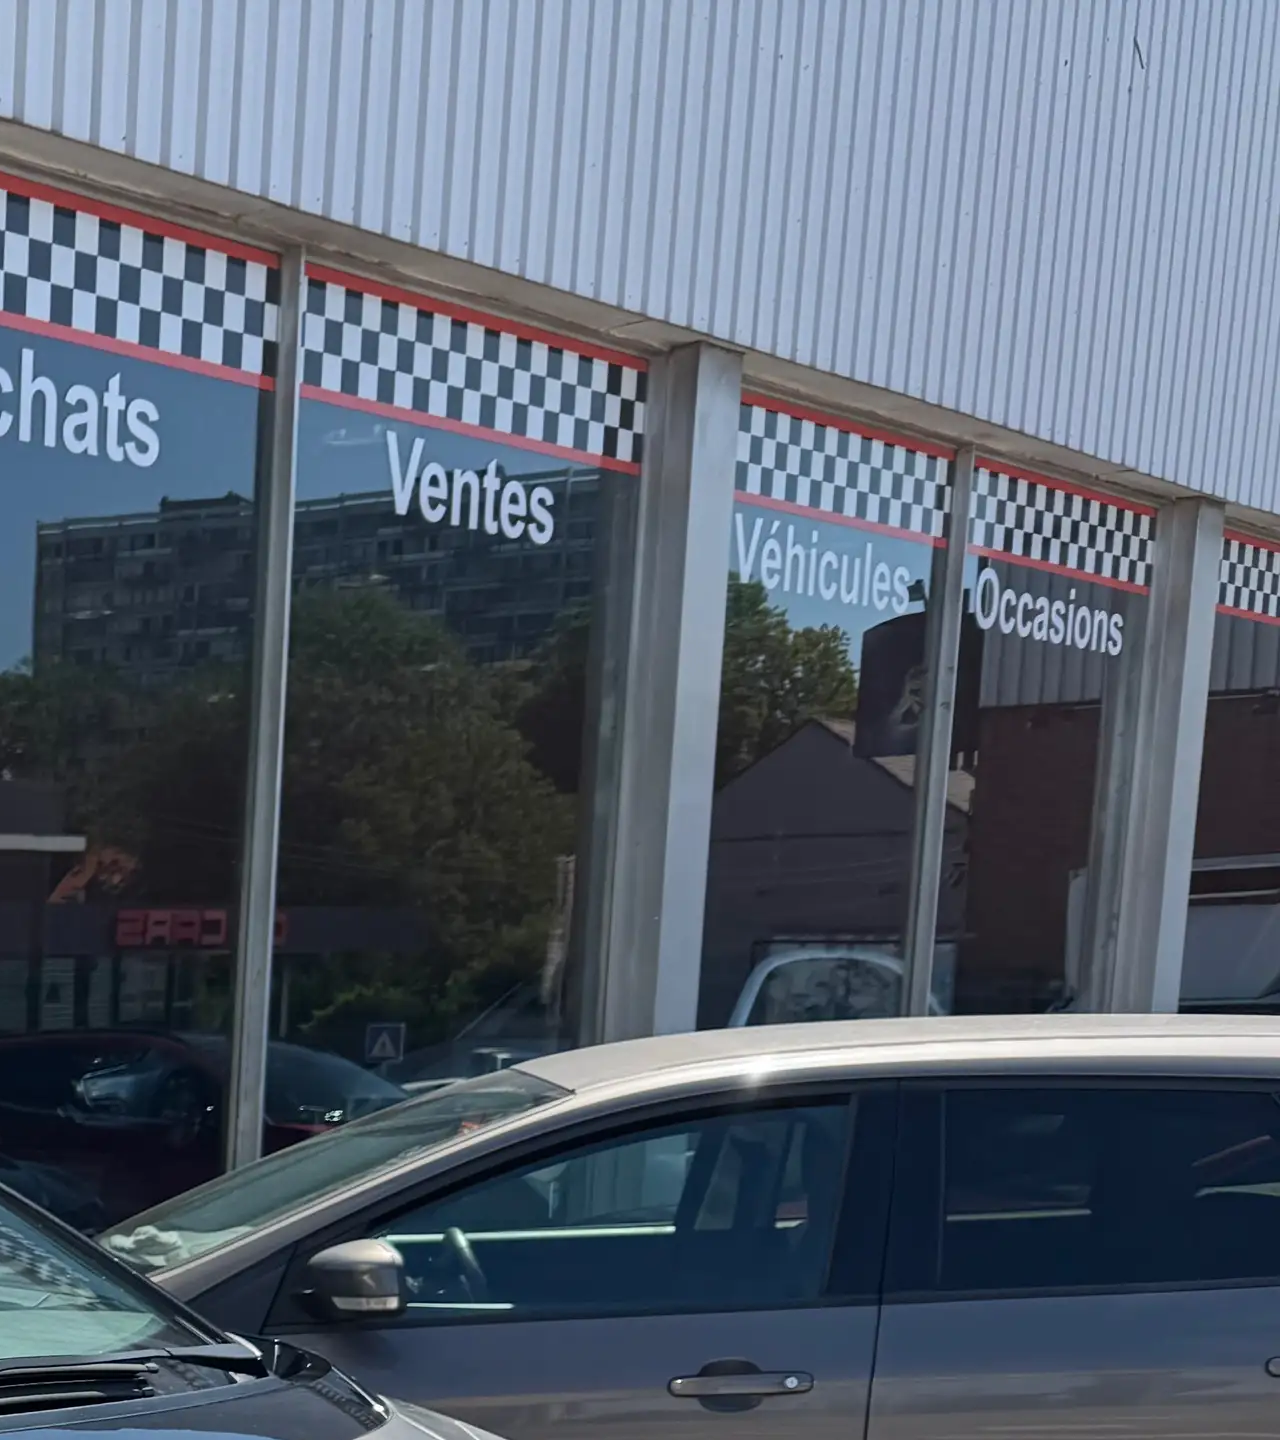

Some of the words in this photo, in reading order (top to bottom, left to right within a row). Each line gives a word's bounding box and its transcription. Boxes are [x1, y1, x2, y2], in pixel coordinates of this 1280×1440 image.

[386, 430, 555, 544] Ventes
[735, 513, 911, 613] Véhicules
[975, 567, 1124, 656] Occasions
